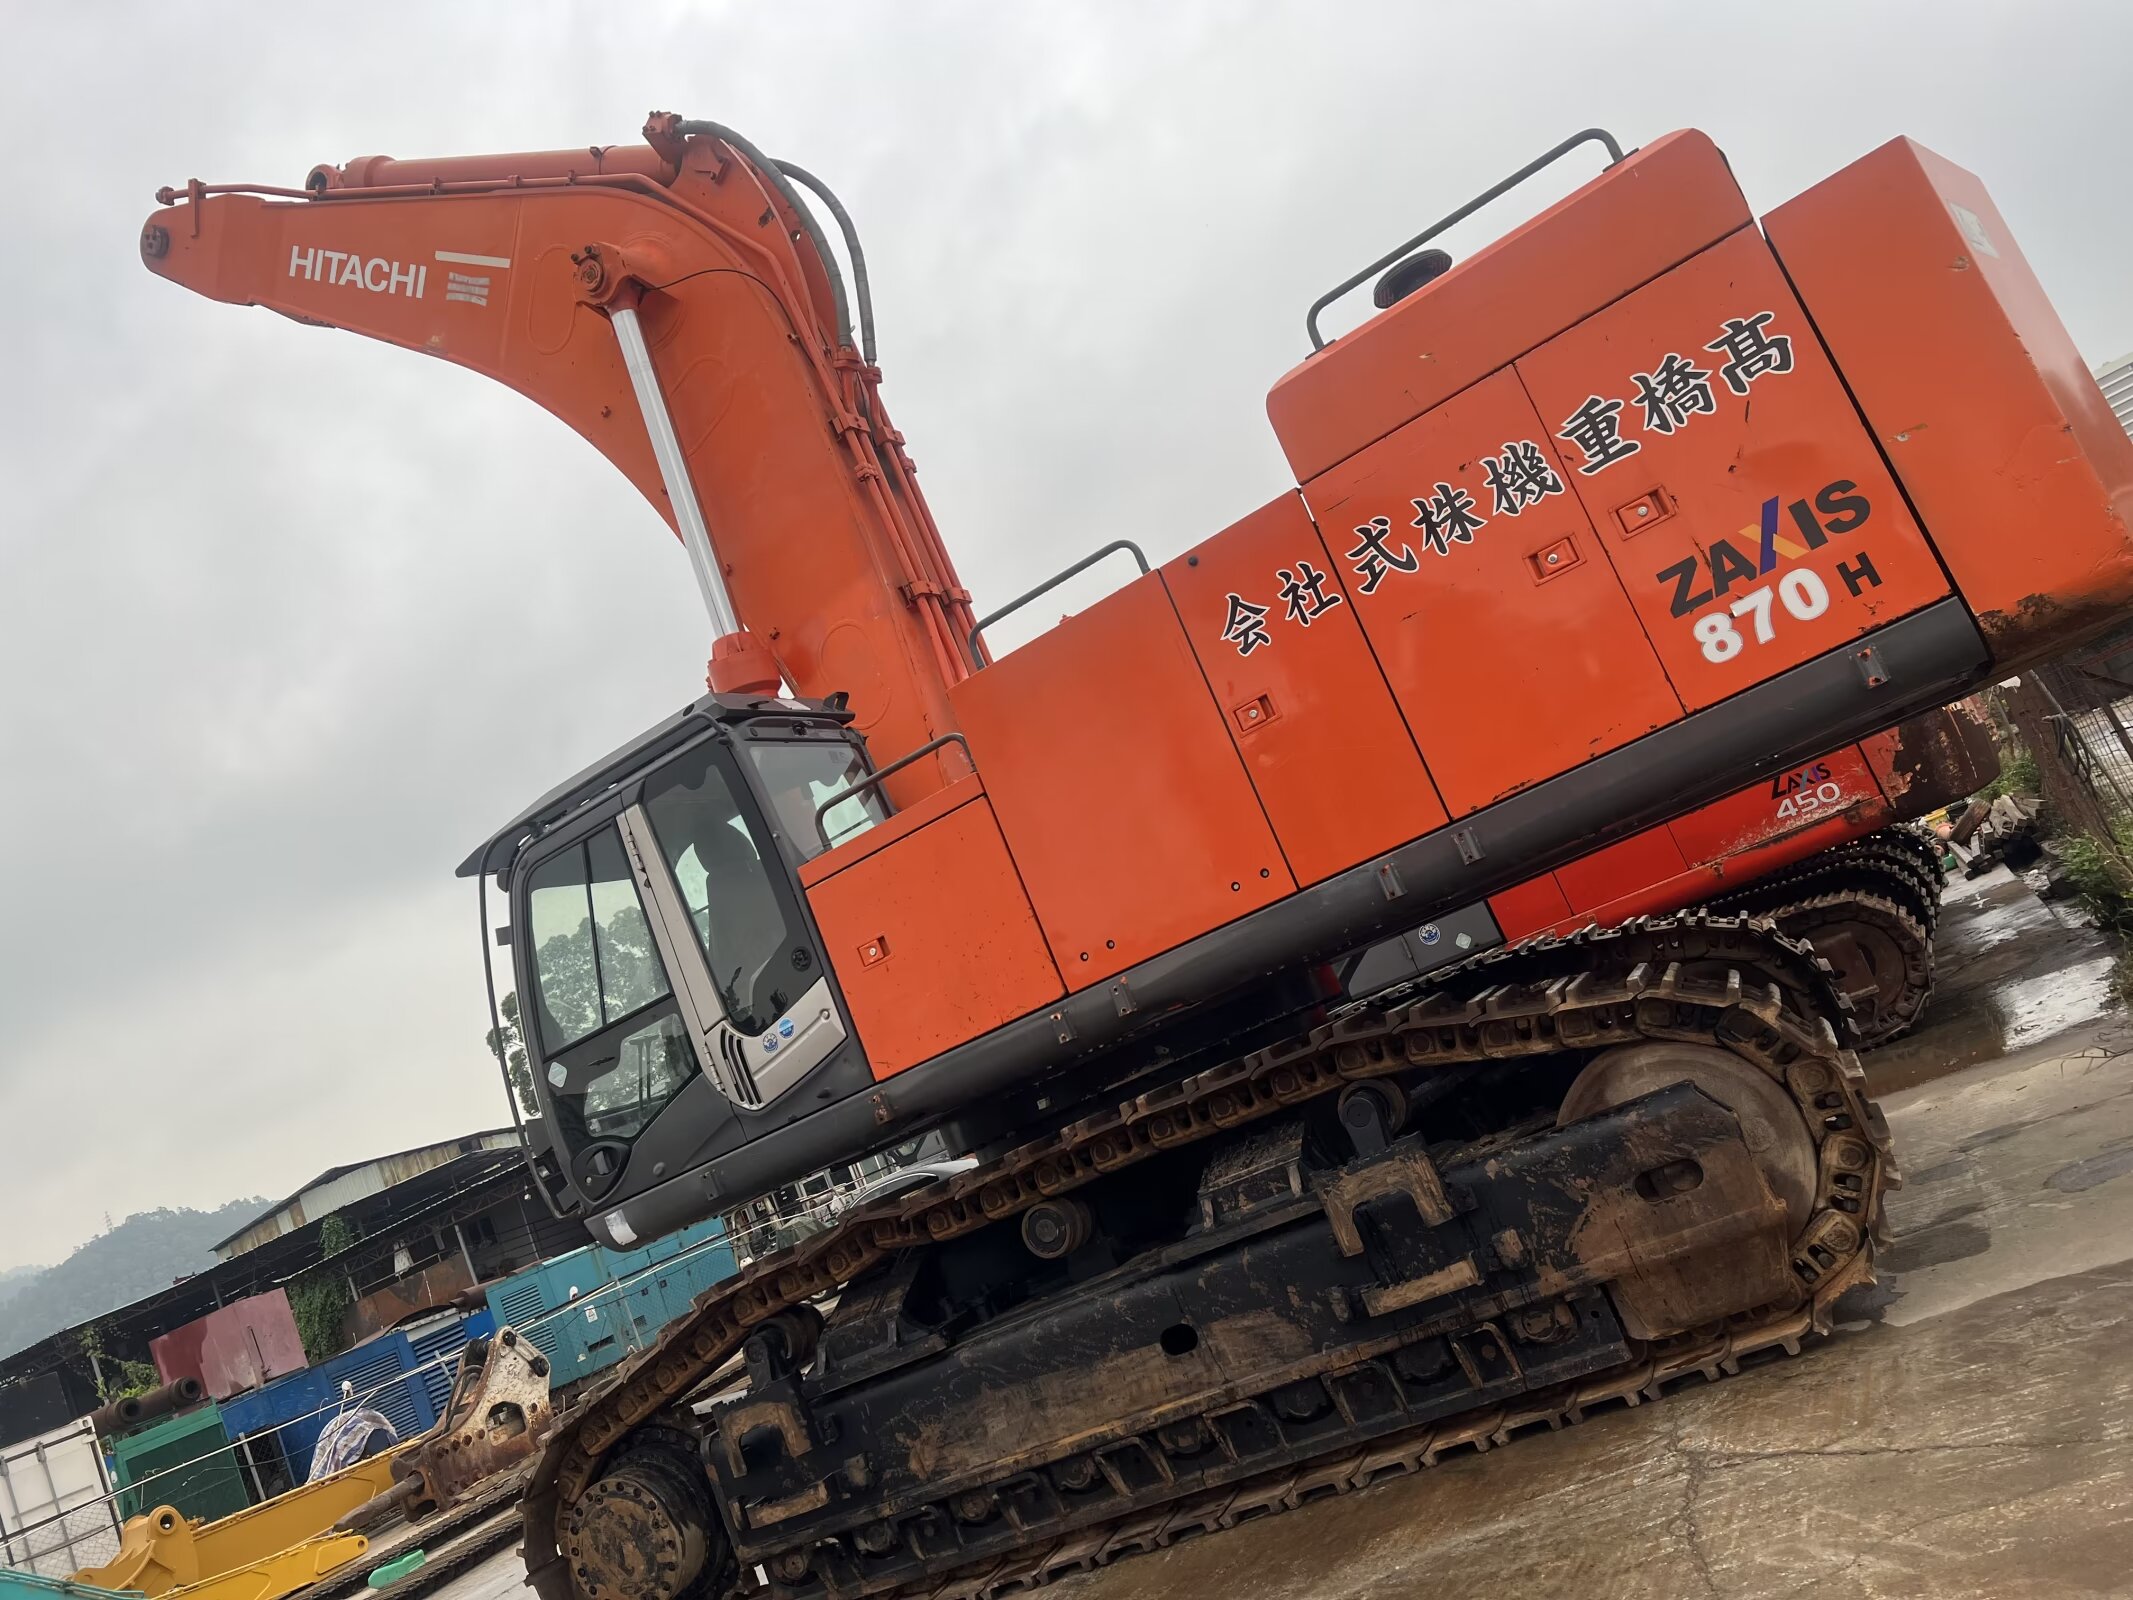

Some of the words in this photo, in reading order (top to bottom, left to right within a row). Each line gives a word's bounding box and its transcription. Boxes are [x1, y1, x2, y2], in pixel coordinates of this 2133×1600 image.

[289, 245, 427, 299] HITACHI
[1656, 480, 1871, 618] ZAXIS
[1693, 567, 1830, 664] 870
[1836, 551, 1883, 598] H
[1776, 782, 1840, 819] 450
